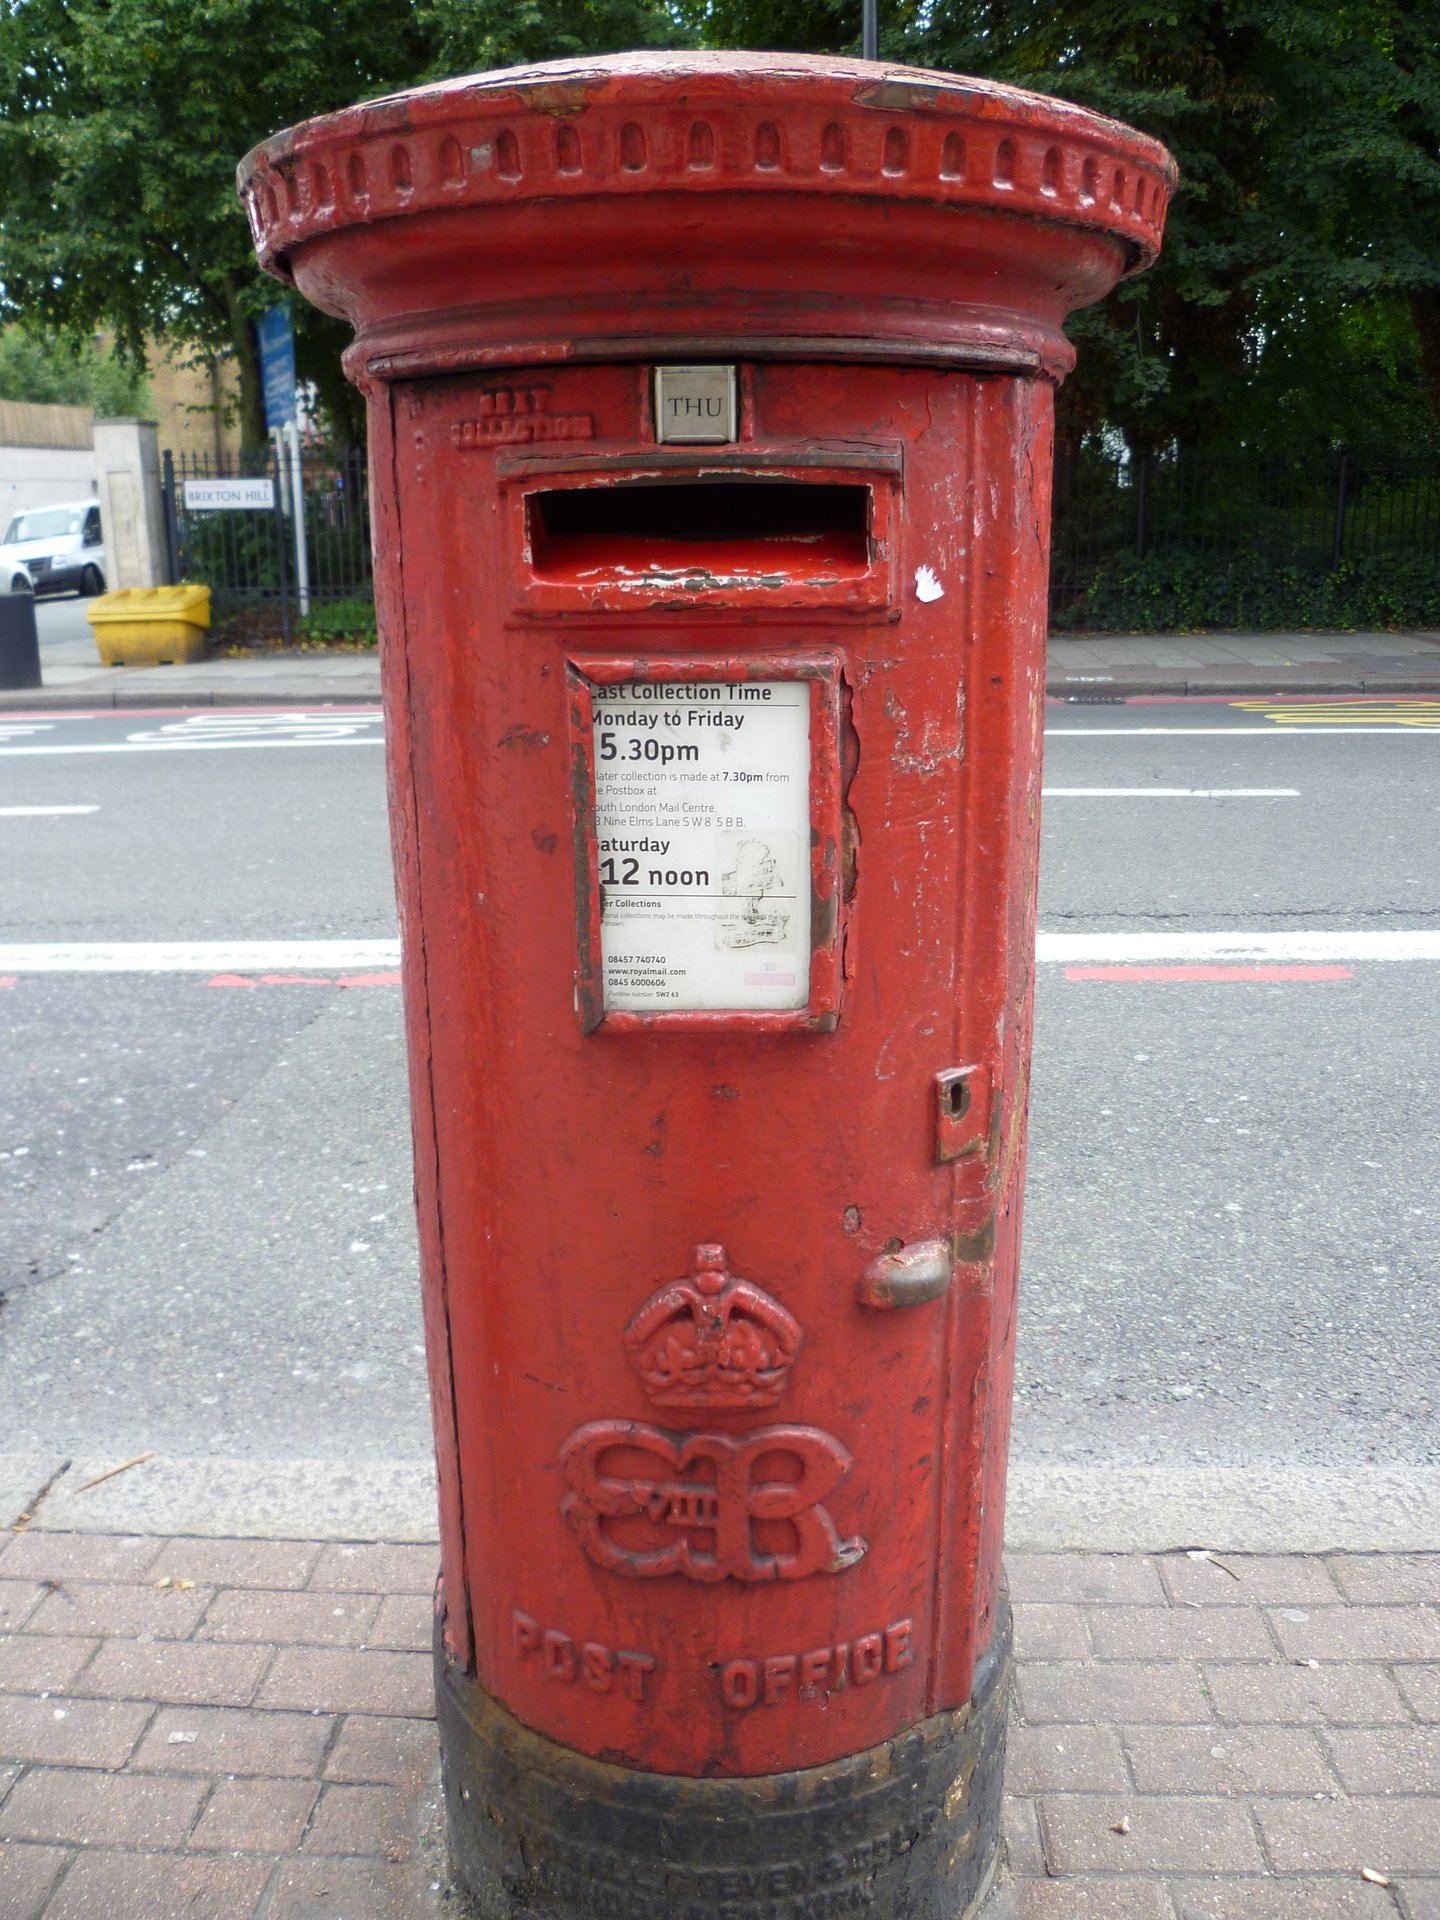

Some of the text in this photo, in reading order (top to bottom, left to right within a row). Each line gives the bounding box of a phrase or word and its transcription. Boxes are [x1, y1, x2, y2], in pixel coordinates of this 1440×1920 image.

[667, 396, 724, 418] THU
[188, 489, 270, 502] BRIXTON HILL
[631, 683, 720, 700] Collection
[725, 683, 772, 700] Time
[593, 710, 744, 730] Monday to Friday
[600, 732, 699, 766] 5.30pm
[596, 771, 790, 783] later collection is made at 7.30pm from
[606, 785, 645, 795] Postbox
[647, 786, 657, 795] at
[595, 802, 717, 814] outh London Mail Centre,
[603, 816, 627, 826] Nine
[629, 816, 653, 826] Elms
[656, 816, 680, 826] Lane
[597, 836, 670, 855] aturday
[600, 857, 709, 886] 12 noon
[615, 899, 662, 908] Collections
[608, 955, 666, 964] 08457 740740
[608, 968, 686, 976] www.royalmail.com
[608, 978, 629, 986] 0845
[511, 1608, 915, 1710] POST OFFICE
